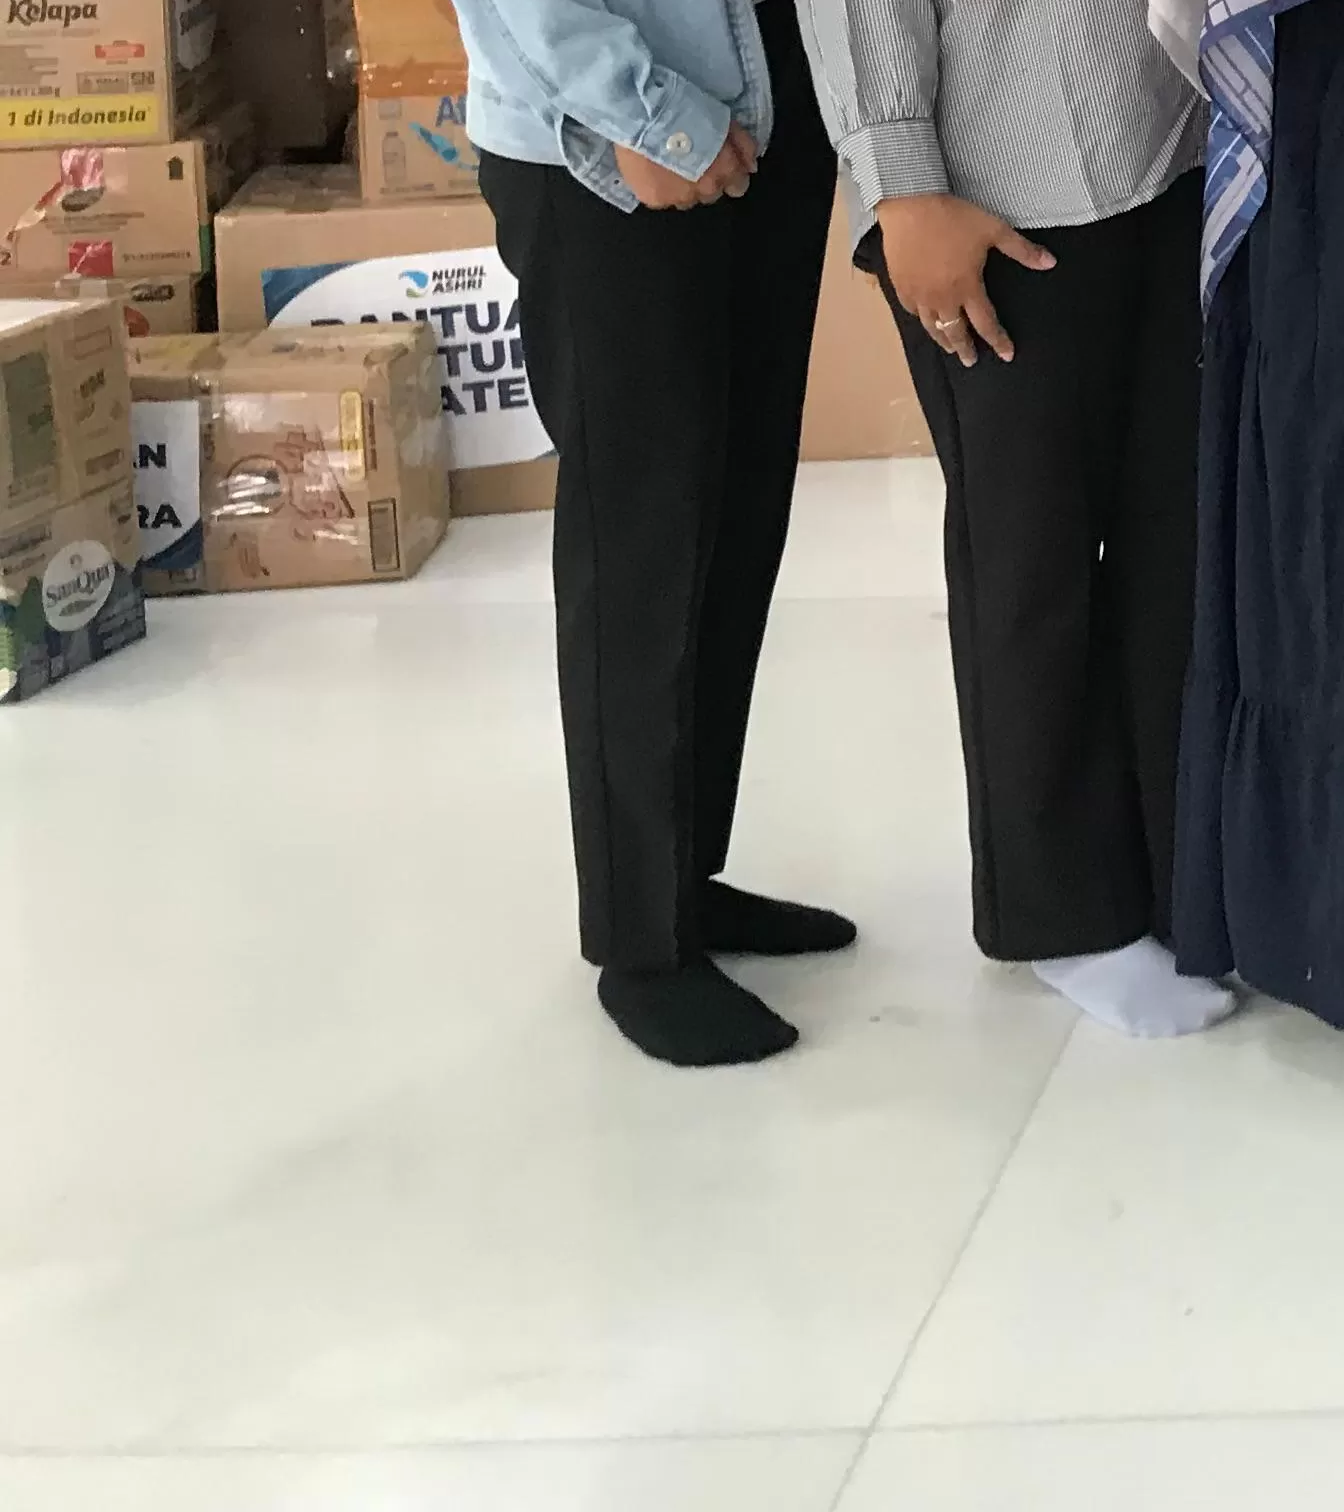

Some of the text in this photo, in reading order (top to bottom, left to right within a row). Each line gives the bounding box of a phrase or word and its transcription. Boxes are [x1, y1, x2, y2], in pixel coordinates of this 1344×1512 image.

[24, 108, 43, 126] di
[47, 104, 147, 127] Indonesia
[431, 265, 488, 280] NURUL
[431, 278, 484, 294] ASHRI
